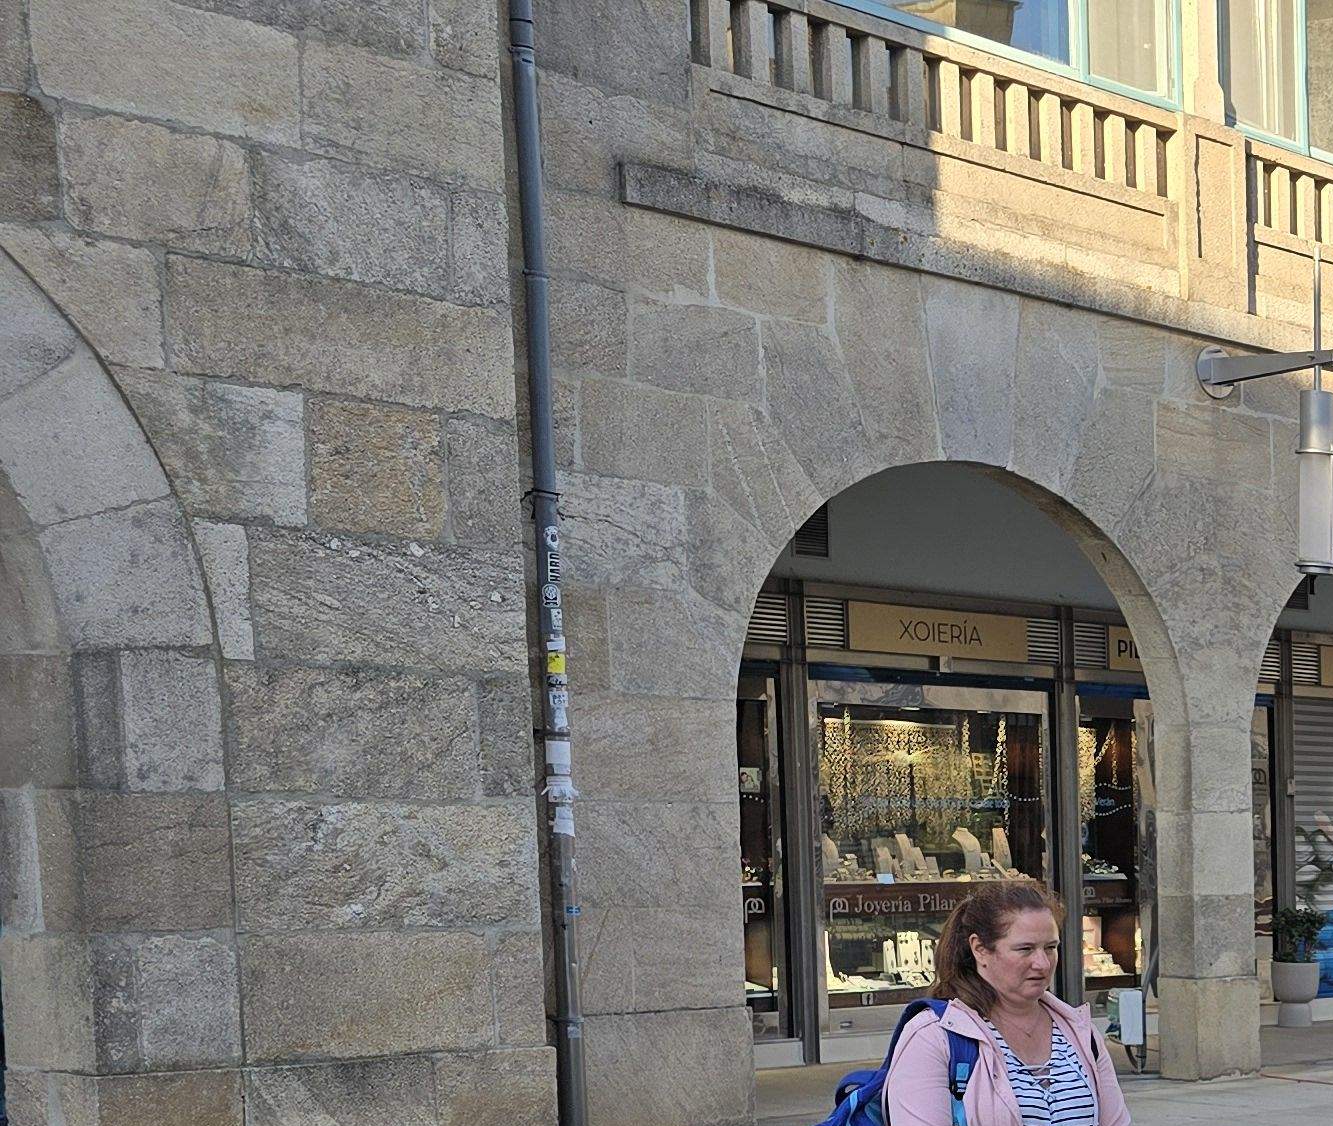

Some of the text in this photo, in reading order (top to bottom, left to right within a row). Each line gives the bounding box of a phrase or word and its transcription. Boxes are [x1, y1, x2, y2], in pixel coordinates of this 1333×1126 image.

[899, 619, 983, 646] XOIERÍA
[1117, 639, 1140, 659] PIL
[855, 894, 912, 915] Joyería
[918, 893, 957, 912] Pilar
